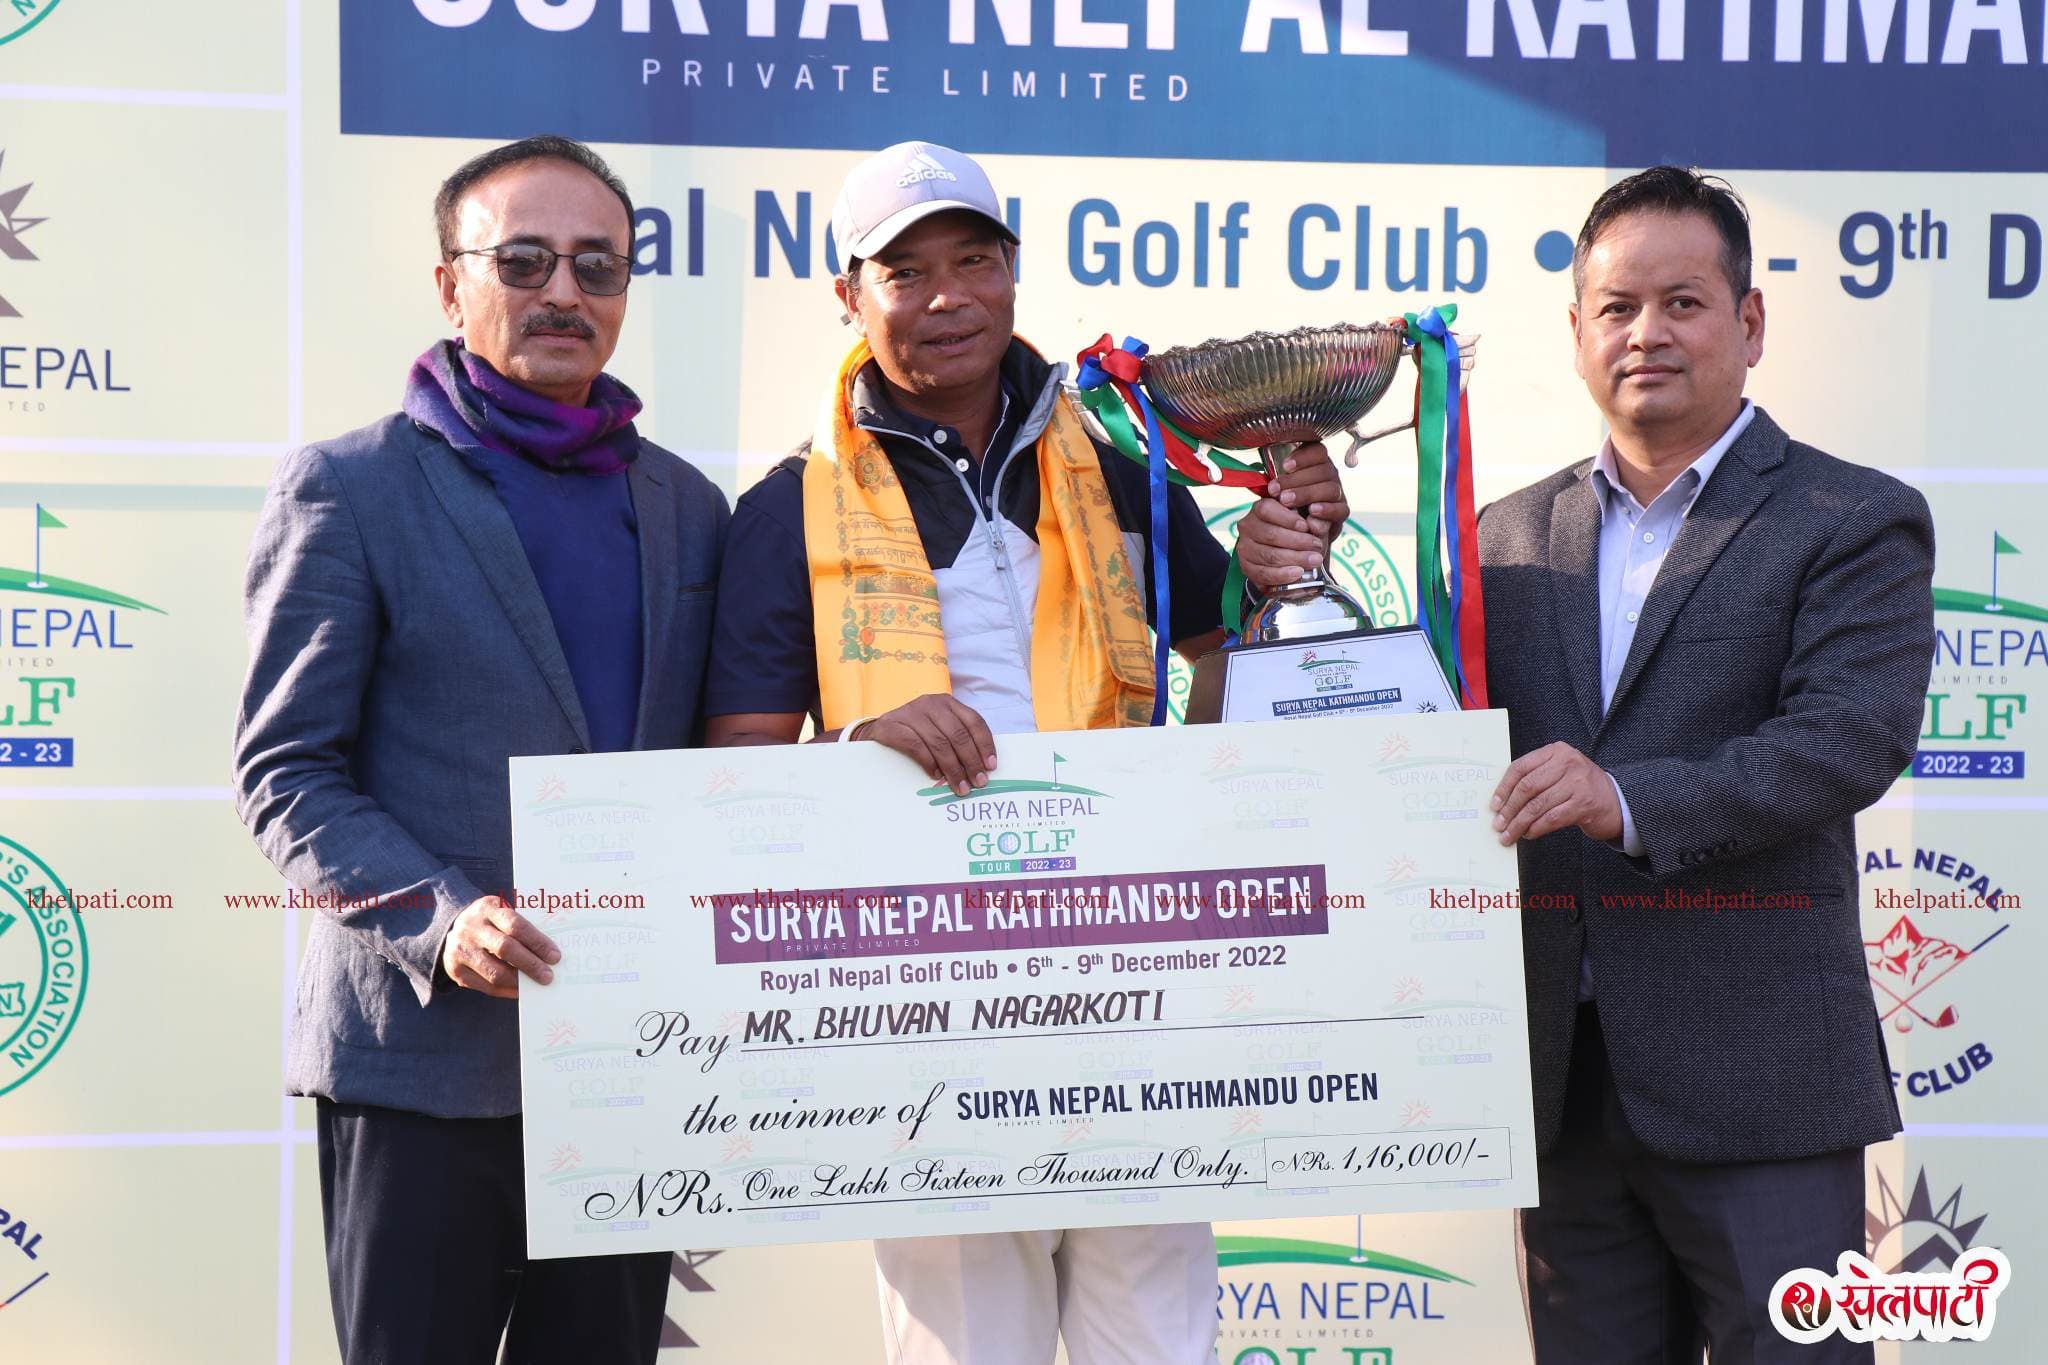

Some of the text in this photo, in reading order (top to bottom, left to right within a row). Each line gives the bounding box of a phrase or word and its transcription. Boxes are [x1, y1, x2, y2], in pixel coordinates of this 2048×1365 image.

[642, 58, 1190, 102] PRIVATE LIMITED
[896, 167, 957, 188] adidas
[1068, 198, 1249, 289] Golf
[1287, 203, 1488, 294] Club
[1839, 208, 1947, 300] 9th
[0, 346, 131, 391] EPAL
[0, 608, 133, 649] EPAL
[1936, 629, 2048, 667] NEPA
[1314, 675, 1352, 687] GOLF
[1932, 675, 2008, 685] LIMITED
[1275, 702, 1301, 713] SURYA
[1302, 698, 1327, 710] NEPAL
[1328, 692, 1375, 707] KATHMANDU
[1377, 689, 1399, 700] OPEN
[1920, 694, 2027, 740] LF
[35, 742, 62, 763] 23
[1922, 755, 1970, 775] 2022
[1990, 755, 2014, 775] 23
[946, 797, 1100, 822] SURYA NEPAL
[966, 828, 1076, 857] GOLF
[979, 862, 1011, 873] TOUR
[1025, 860, 1050, 872] 2022
[1059, 859, 1071, 869] 23
[1914, 848, 2004, 913] NEPAL
[730, 876, 1312, 944] SURYA NEPAL KATHMANDU OPEN
[786, 939, 920, 953] PRIVATE LIMITED
[9, 885, 75, 1068] ASSOCIATION
[761, 967, 820, 994] Royal
[829, 964, 891, 992] Nepal
[900, 961, 943, 984] Golf
[950, 959, 998, 981] Club
[1026, 955, 1053, 978] 6th
[1078, 953, 1103, 975] 9th
[1112, 950, 1220, 974] December
[1228, 944, 1287, 968] 2022
[635, 989, 1165, 1074] Pay MR. BHUVAN NAGARKOTI
[1907, 1042, 1993, 1097] CLUB
[683, 1072, 1379, 1141] the winner of SURYA NEPAL KATHMANDU OPEN
[997, 1117, 1095, 1128] PRIVATE LIMITED
[1271, 1151, 1335, 1173] NRs.
[1342, 1137, 1489, 1175] 1,16,000/-
[584, 1169, 733, 1221] NRs.
[743, 1167, 800, 1201] One
[810, 1164, 890, 1198] Lakh
[900, 1158, 1006, 1192] Sixteen
[1017, 1151, 1164, 1186] Thousand
[1169, 1146, 1248, 1190] Only.
[0, 1208, 42, 1260] PAL
[1301, 1282, 1445, 1320] NEPAL
[1216, 1329, 1375, 1339] RIVATE LIMITED
